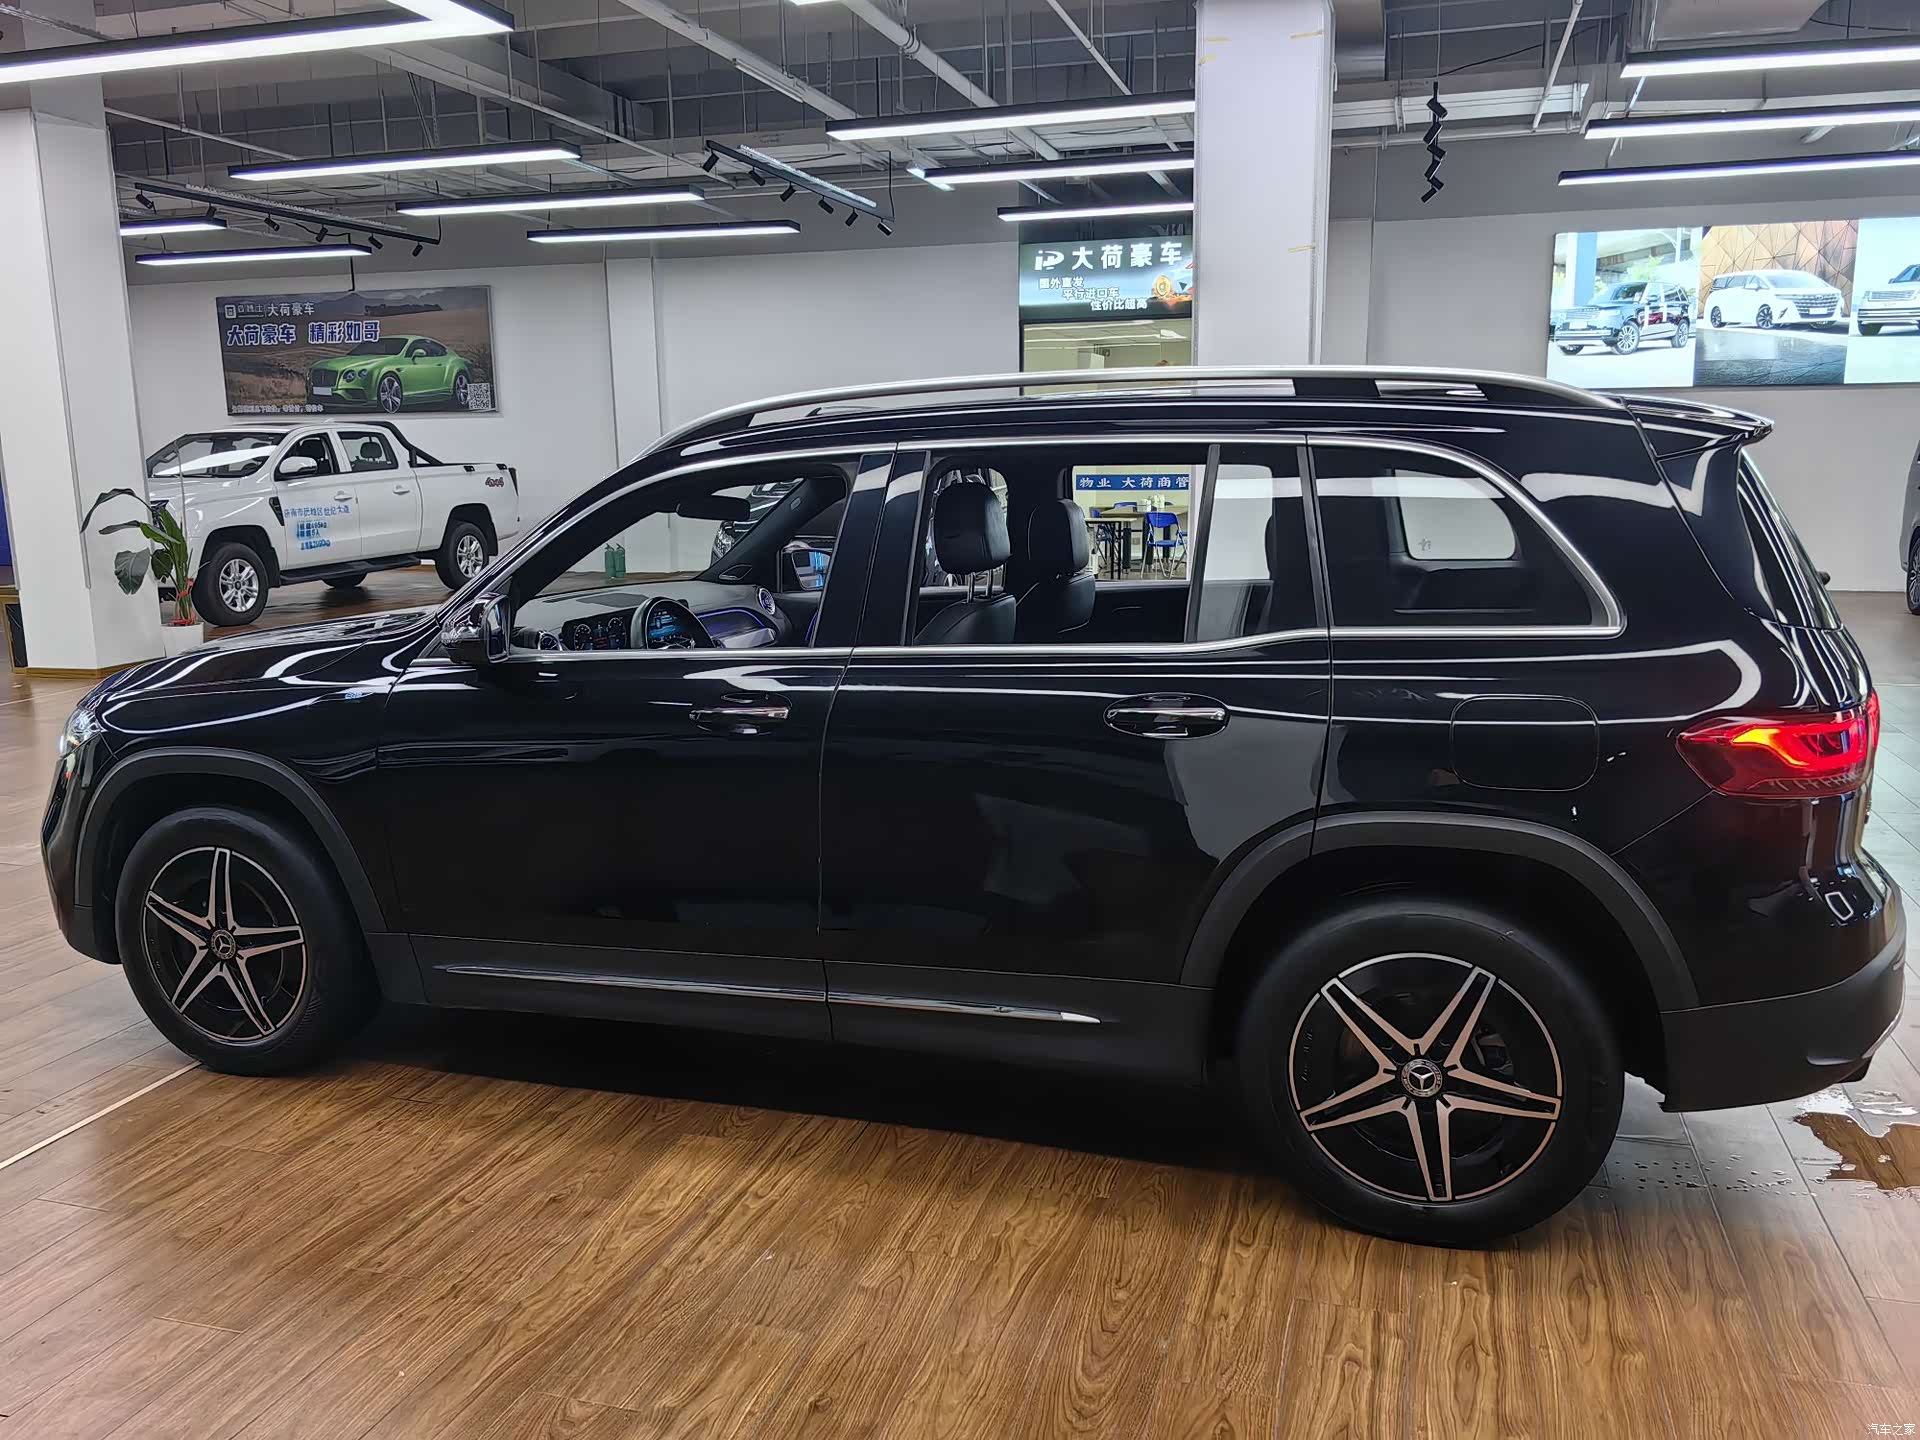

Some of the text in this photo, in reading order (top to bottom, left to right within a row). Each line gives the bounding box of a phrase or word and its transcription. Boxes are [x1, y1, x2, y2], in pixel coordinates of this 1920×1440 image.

[1071, 241, 1182, 271] 大荷豪车
[1062, 287, 1119, 301] 平行进口车
[267, 302, 315, 317] 大荷豪车
[1090, 298, 1148, 311] 性价比超高
[227, 320, 380, 346] 大荷豪车 精彩如哥
[1079, 476, 1190, 489] 物业 大荷商管
